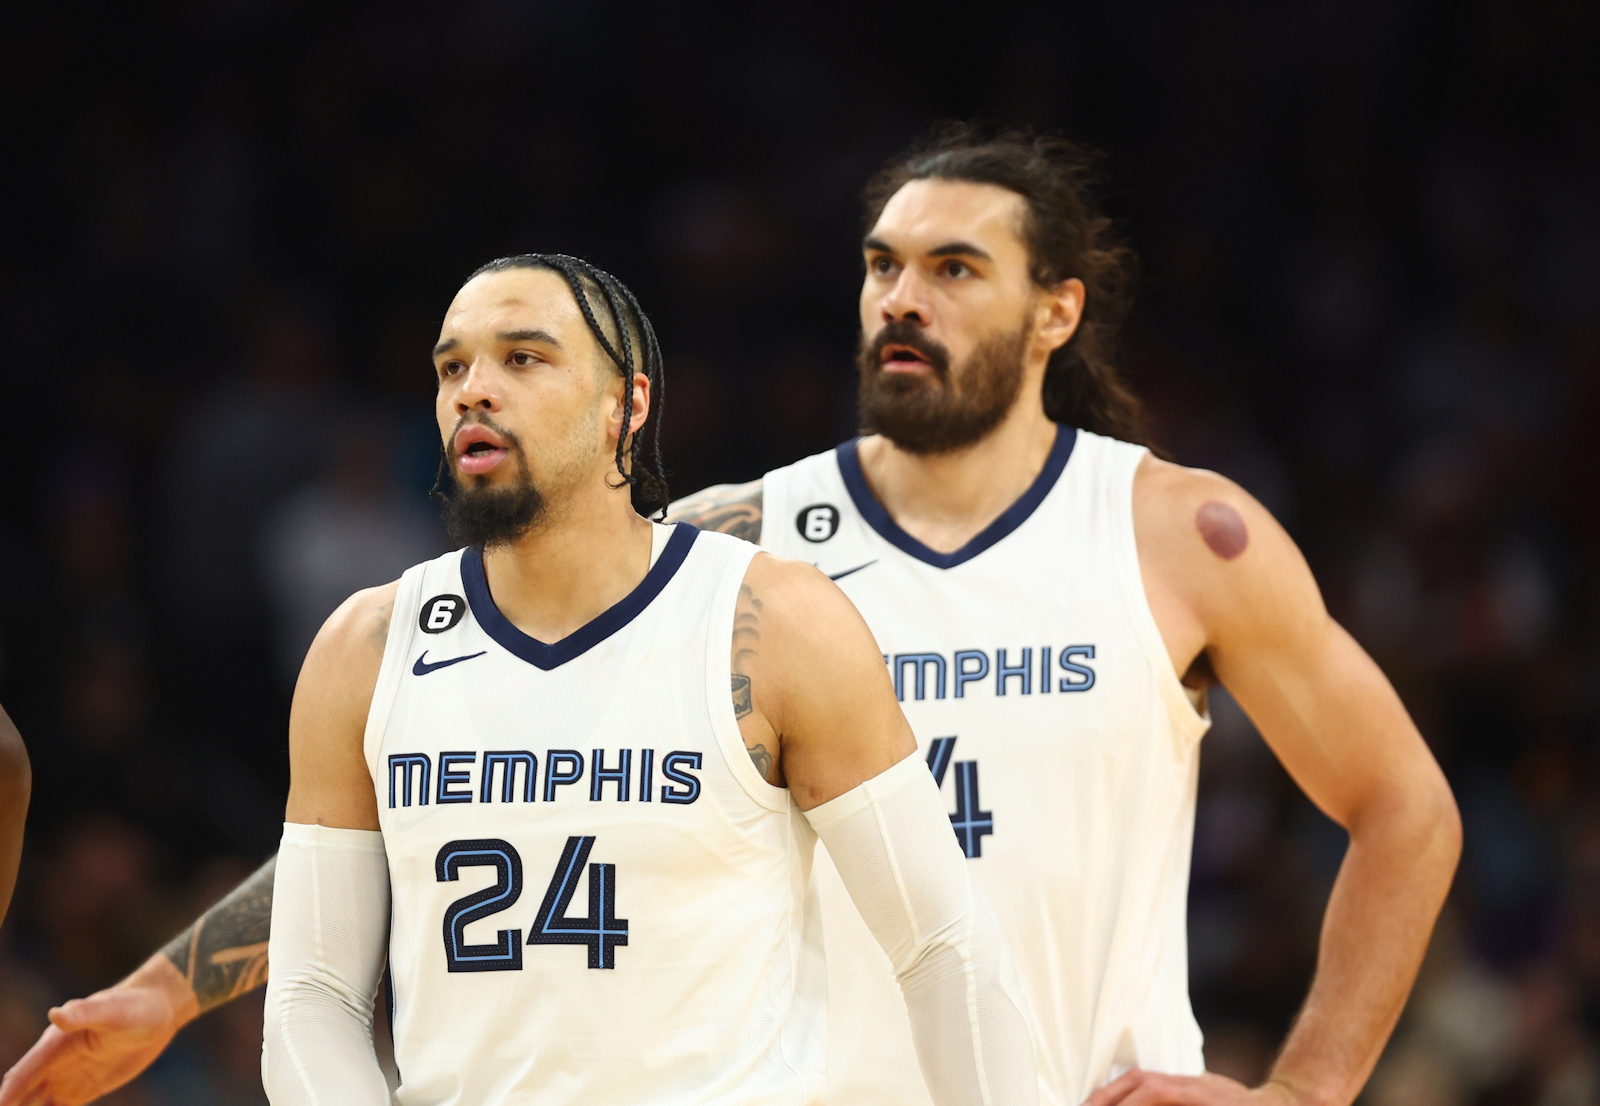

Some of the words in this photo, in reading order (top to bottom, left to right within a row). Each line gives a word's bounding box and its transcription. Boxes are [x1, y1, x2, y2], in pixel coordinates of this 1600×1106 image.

[804, 506, 833, 540] 6
[427, 600, 456, 630] 6
[884, 644, 1096, 702] MPHIS
[388, 748, 703, 809] MEMPHIS
[435, 835, 629, 973] 24
